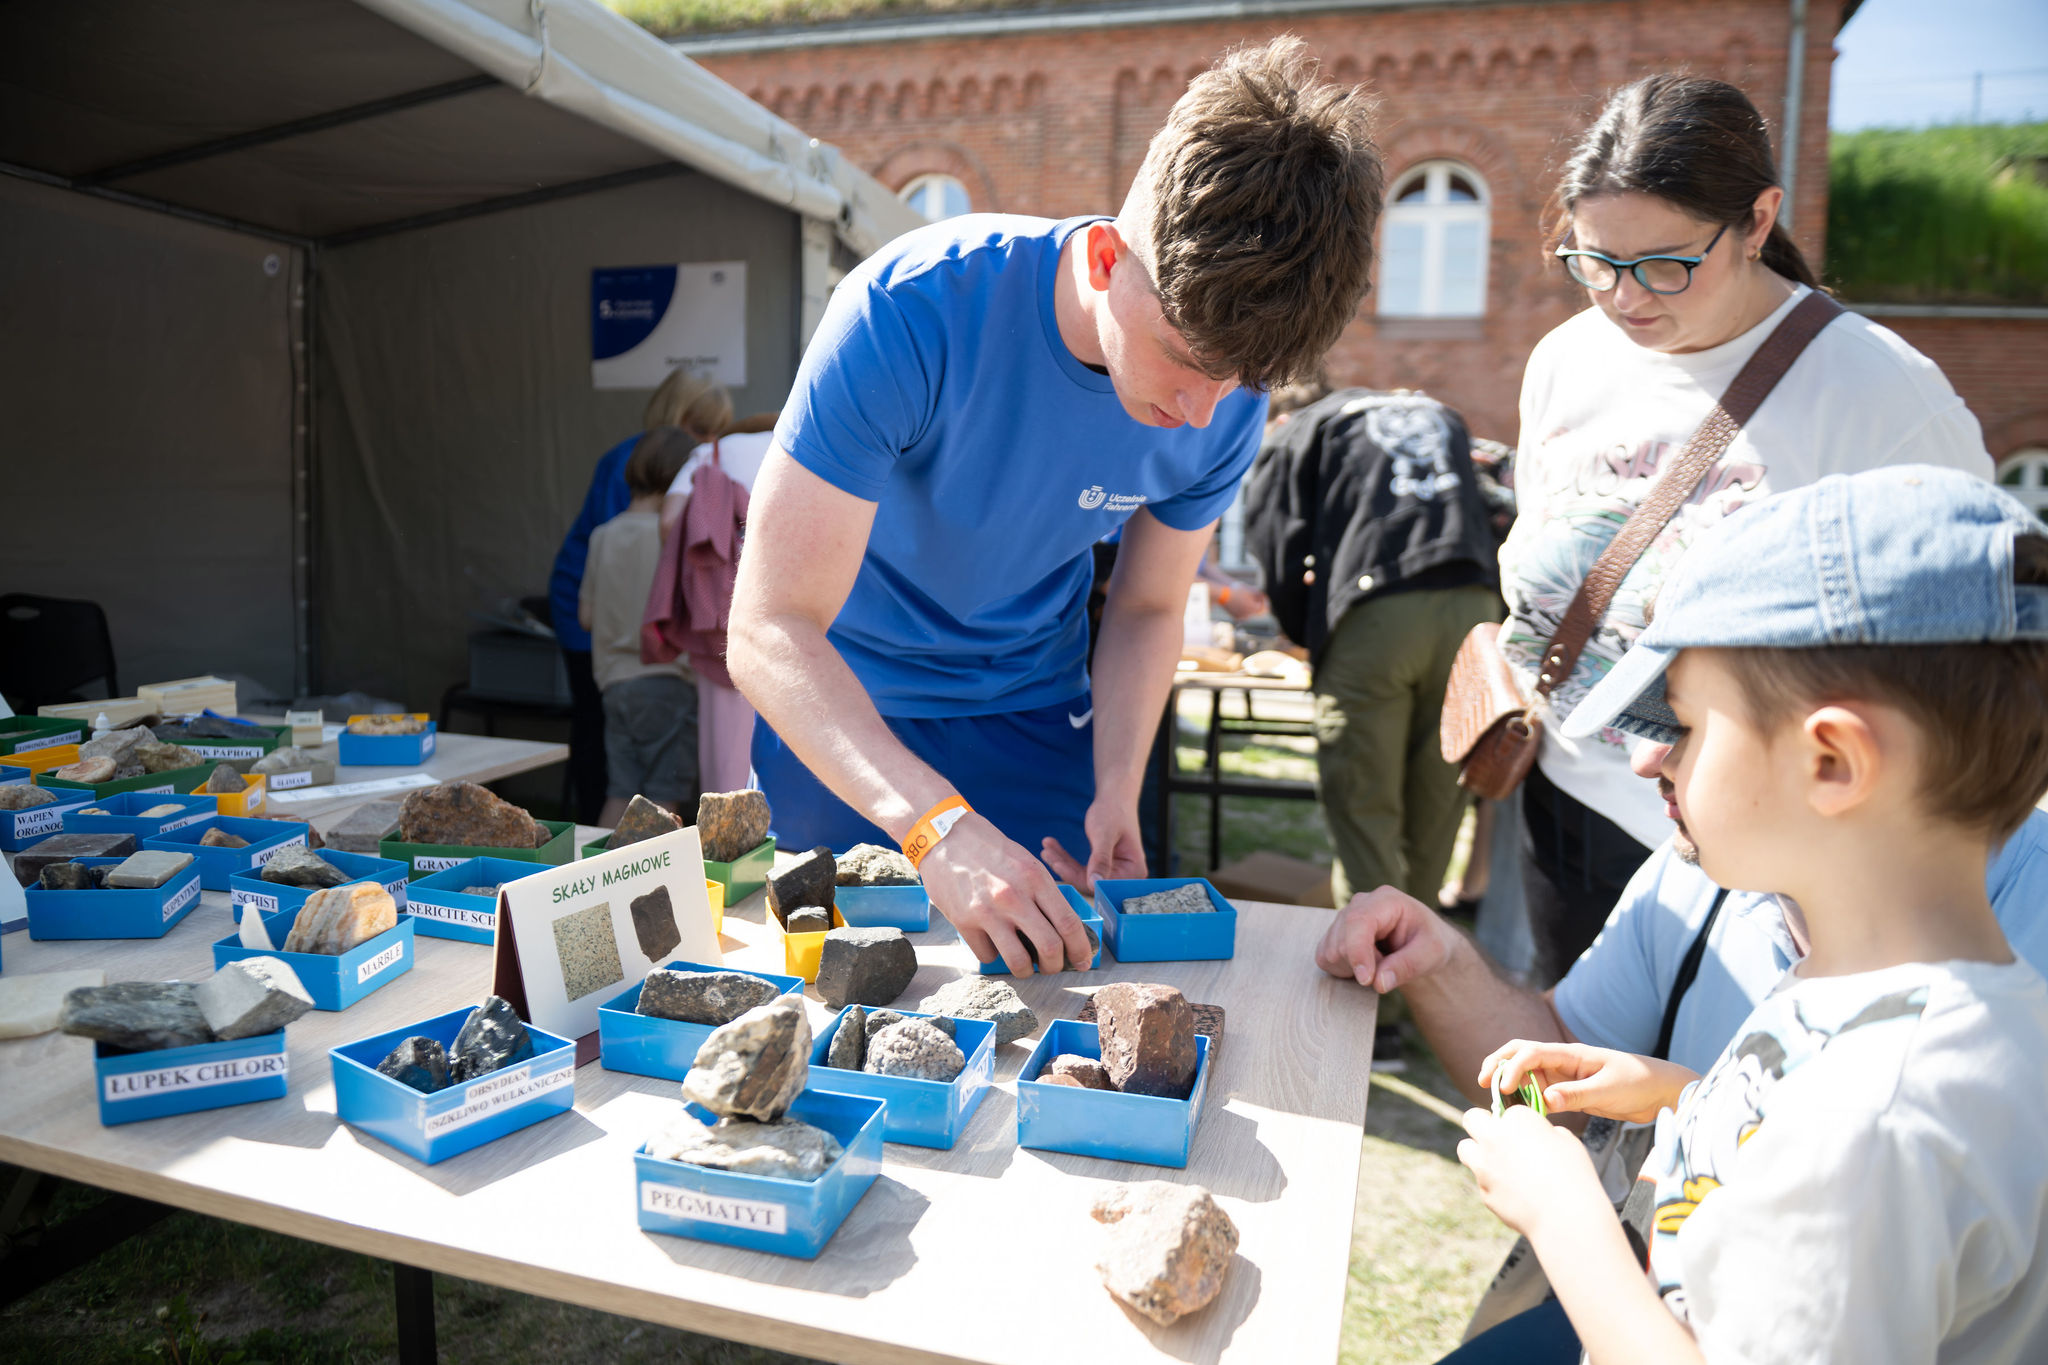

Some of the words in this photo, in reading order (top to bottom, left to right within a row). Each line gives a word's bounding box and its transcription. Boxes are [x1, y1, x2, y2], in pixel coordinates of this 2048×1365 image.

[213, 748, 260, 758] PAPROCI
[16, 808, 54, 825] WAPIEŃ
[16, 821, 64, 838] ORGANOG
[552, 875, 596, 904] SKAŁY
[602, 851, 671, 887] MAGMOWE
[237, 892, 277, 909] SCHIST
[408, 902, 468, 922] SERICITE
[471, 913, 496, 927] SCH
[362, 943, 402, 977] MARBLE
[111, 1069, 190, 1094] ŁUPEK
[469, 1070, 528, 1098] OBSYDIAN
[428, 1100, 488, 1130] (SZKLIWO
[651, 1190, 775, 1225] PEGMATYT
